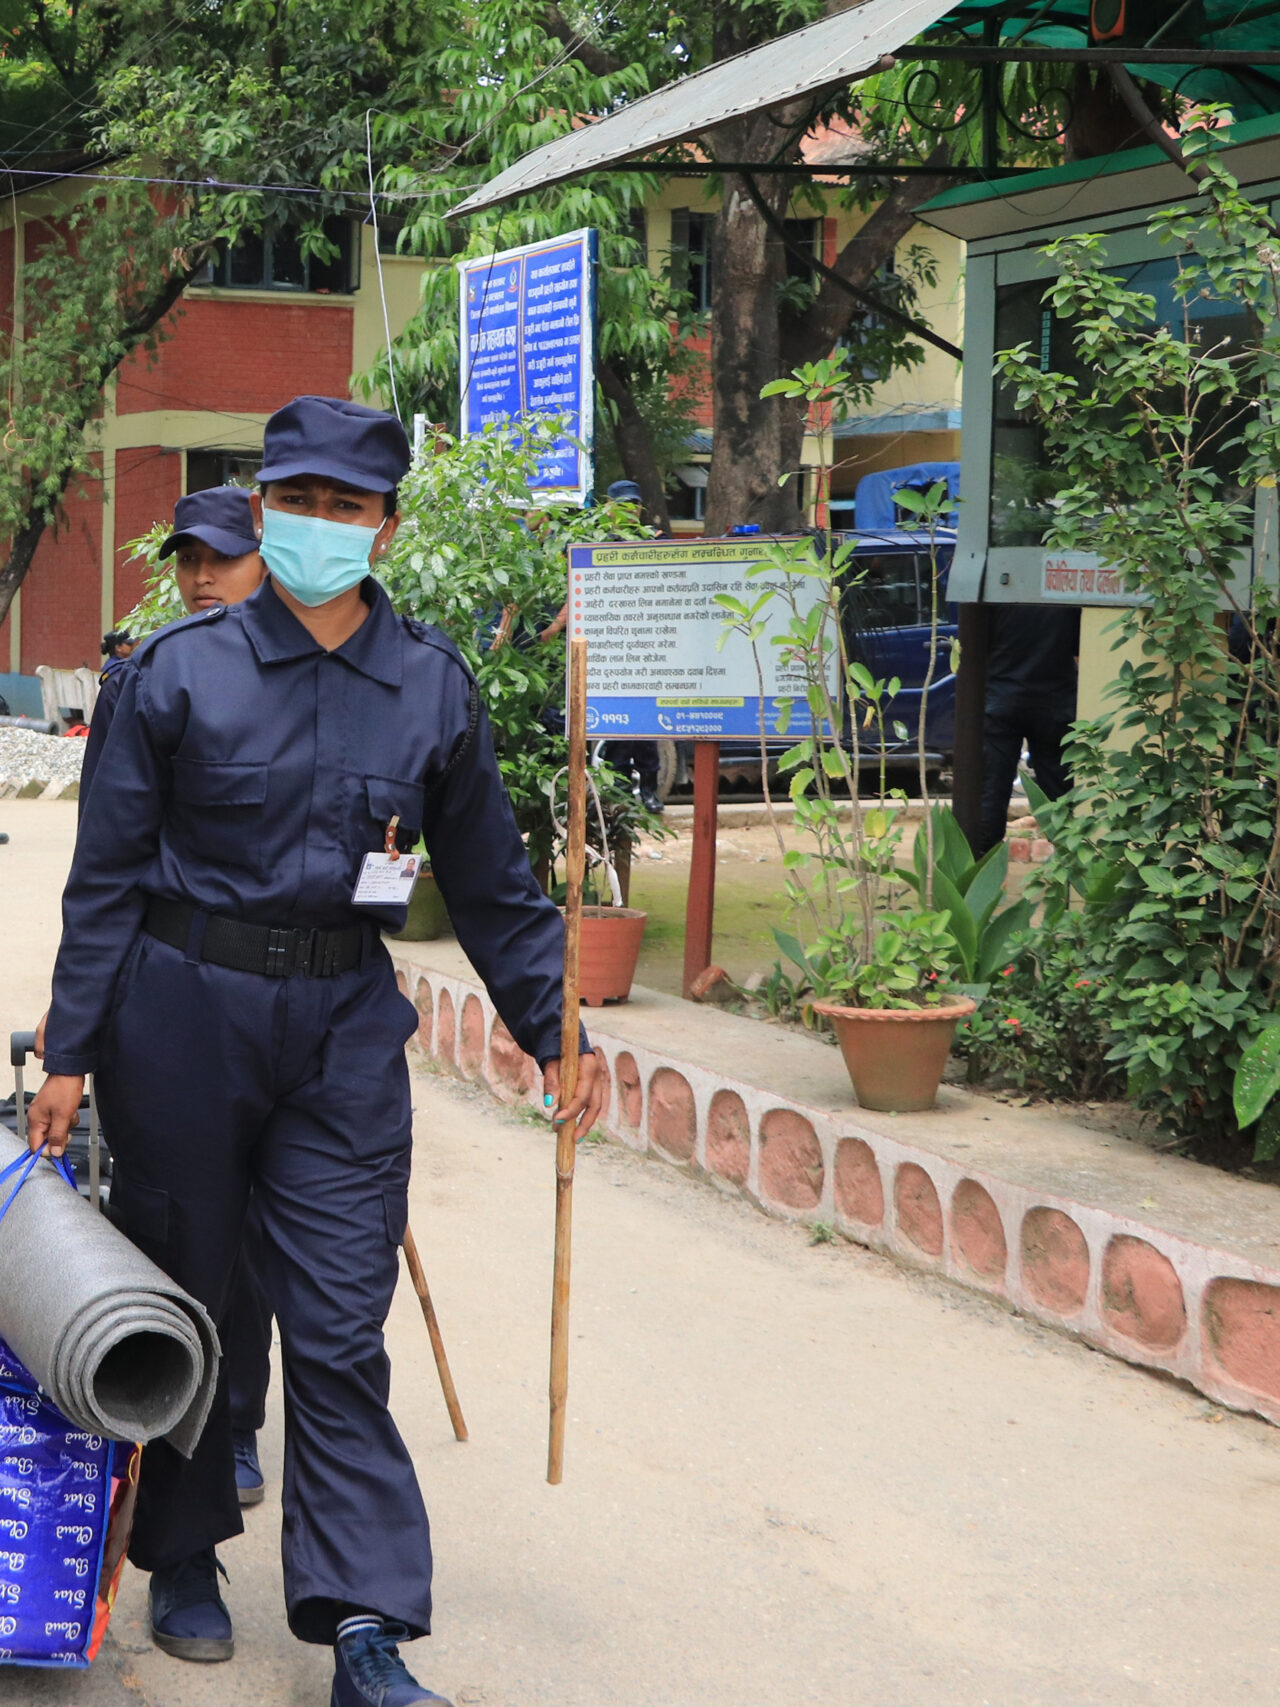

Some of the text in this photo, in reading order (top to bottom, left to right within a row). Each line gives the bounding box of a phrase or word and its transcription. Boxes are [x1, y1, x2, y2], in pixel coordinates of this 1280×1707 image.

[596, 551, 618, 562] प्रहरी
[584, 571, 601, 581] प्रहरी
[603, 571, 615, 580] सेवा
[584, 585, 601, 595] प्रहरी
[584, 598, 604, 608] जाहेरी
[609, 600, 636, 608] दरखास्त
[638, 597, 652, 607] लिन
[603, 680, 618, 690] प्रहरी
[65, 1432, 102, 1451] Cloud
[4, 1456, 33, 1474] Bee
[72, 1461, 98, 1480] Bee
[64, 1493, 96, 1513] Star
[56, 1525, 93, 1545] Cloud
[63, 1557, 89, 1577] Bee
[53, 1589, 86, 1608] Star
[45, 1622, 81, 1640] Cloud
